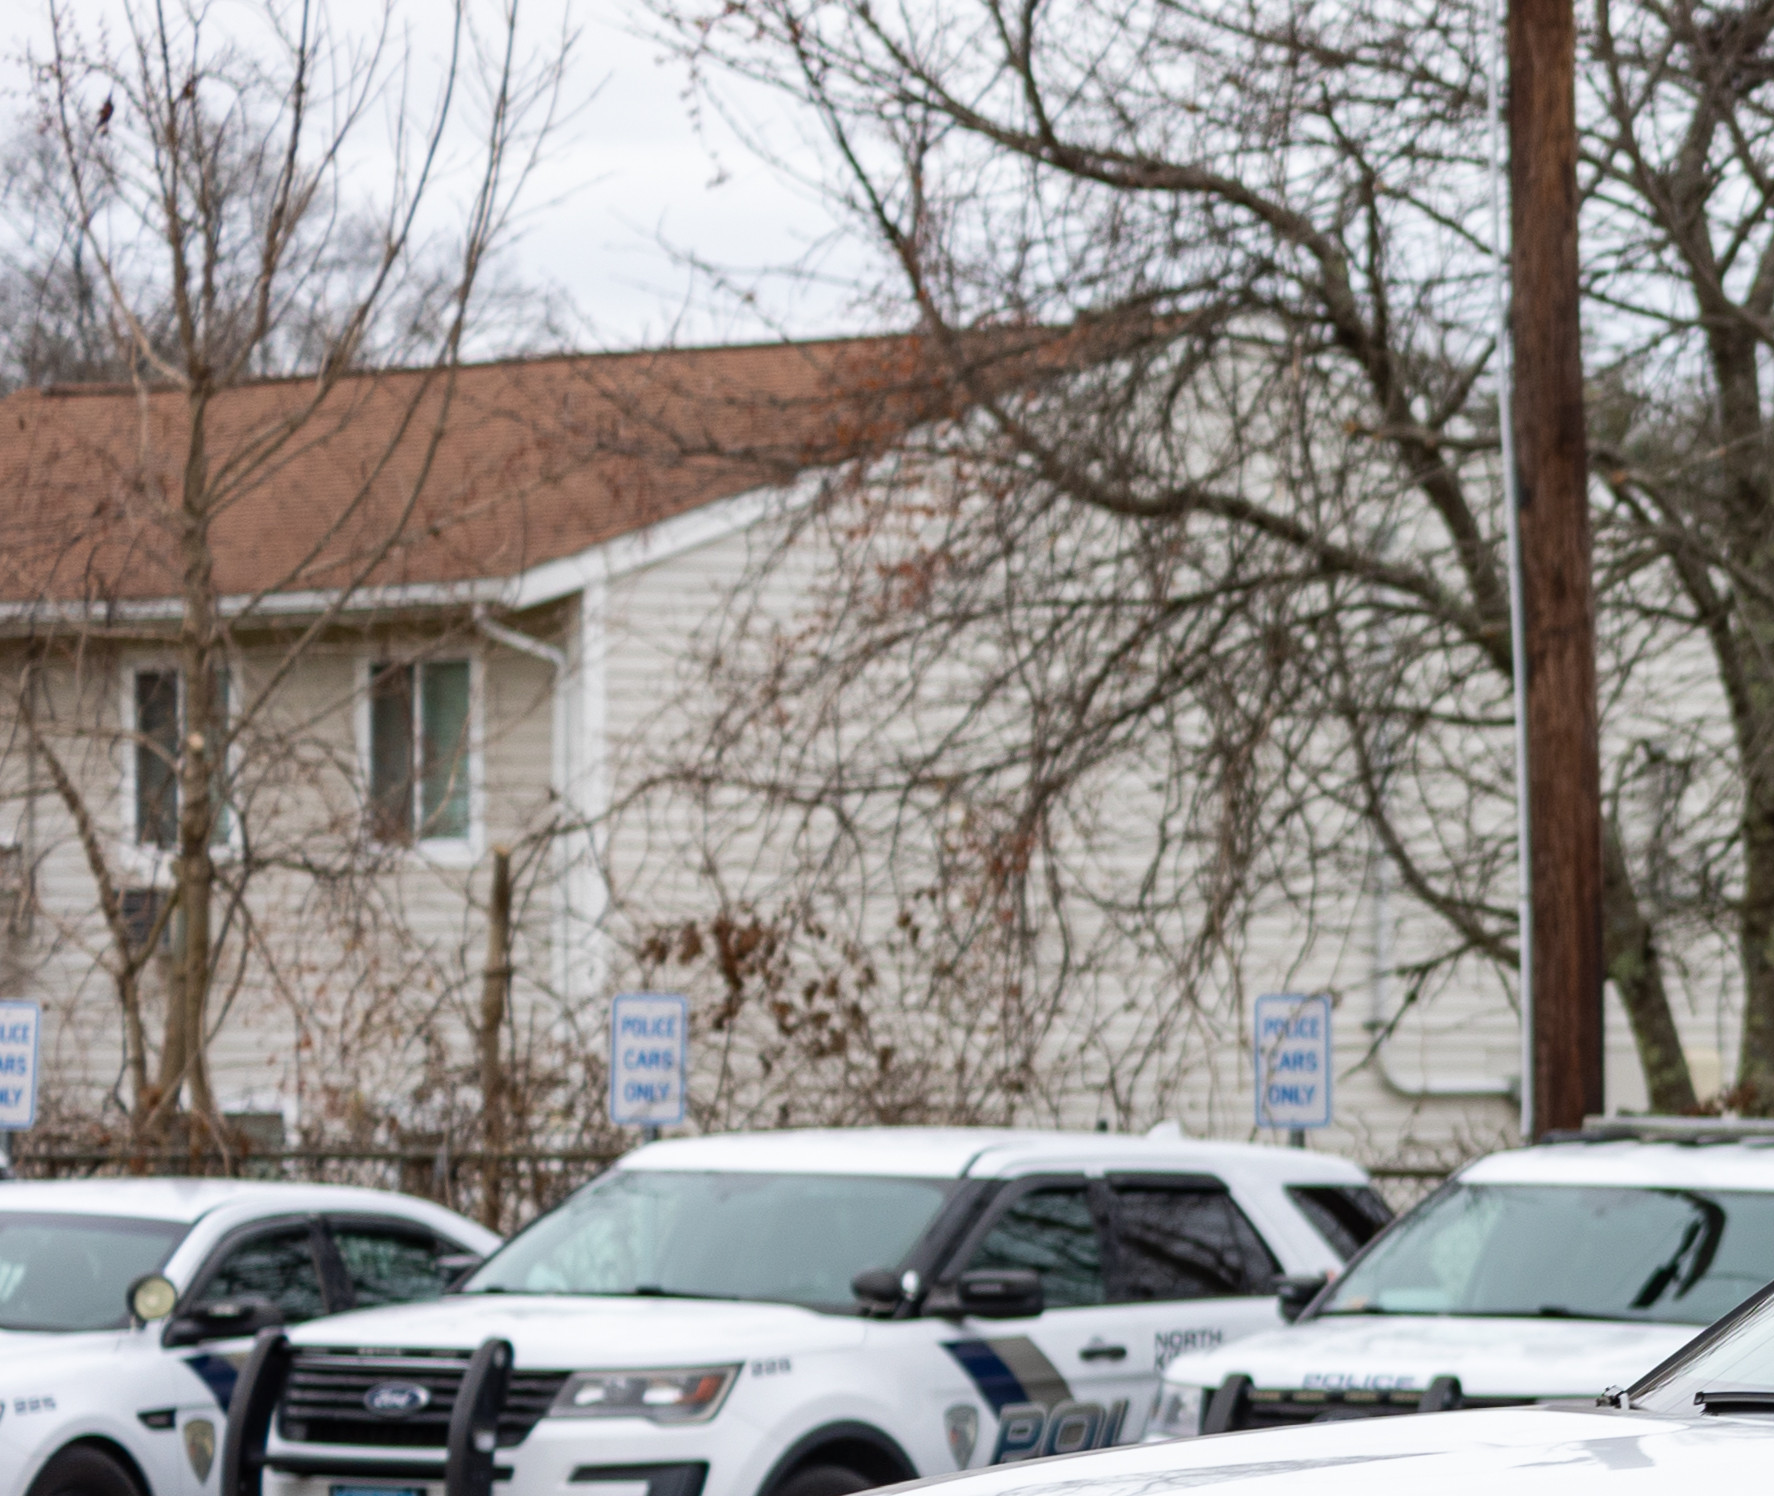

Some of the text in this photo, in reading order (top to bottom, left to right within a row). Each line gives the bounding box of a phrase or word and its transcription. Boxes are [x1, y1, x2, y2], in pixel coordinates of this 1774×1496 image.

[621, 1016, 676, 1037] POLICE
[624, 1049, 673, 1070] CARS
[624, 1082, 670, 1102] ONLY
[1268, 1085, 1315, 1106] ONLY
[1302, 1373, 1415, 1390] POLICE
